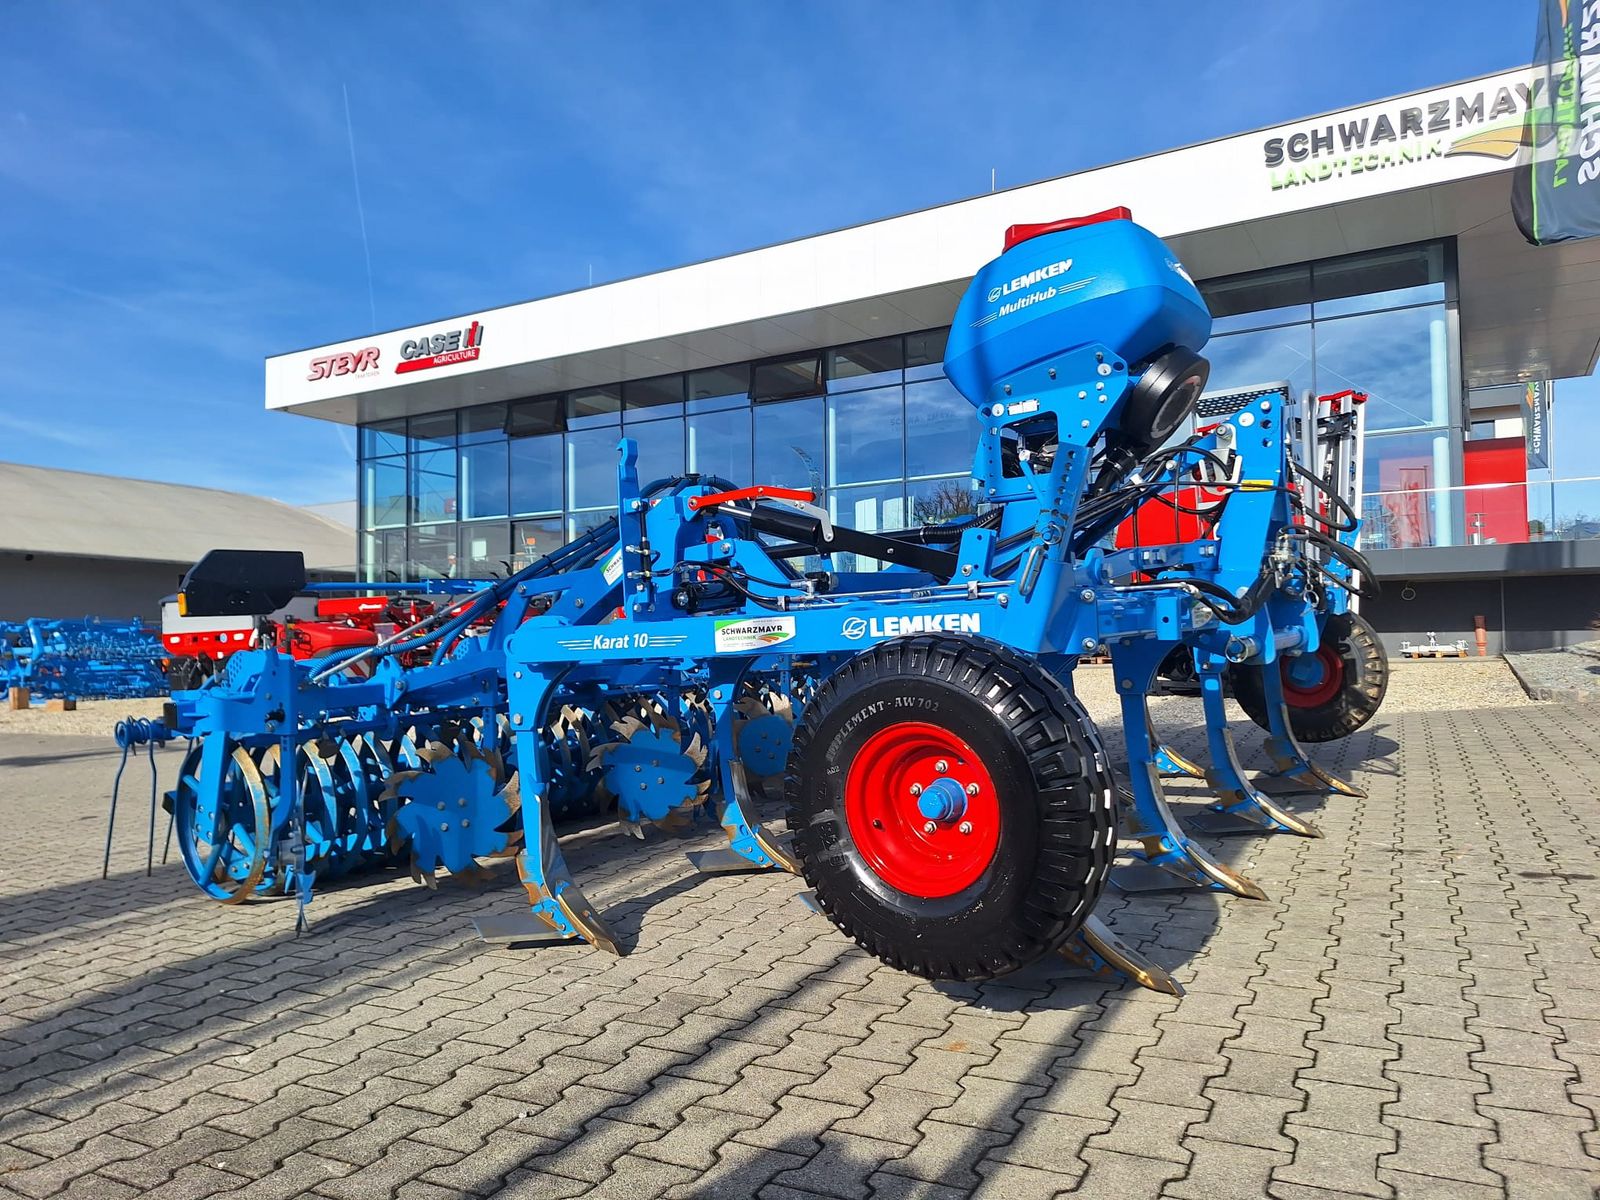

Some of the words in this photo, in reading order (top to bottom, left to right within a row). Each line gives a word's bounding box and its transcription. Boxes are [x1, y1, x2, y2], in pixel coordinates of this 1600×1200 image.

[1270, 138, 1443, 191] LANDTECHNIK
[1002, 258, 1073, 296] LEMKEN
[998, 286, 1057, 317] MultiHub
[400, 330, 462, 360] CASE
[433, 349, 476, 365] AGRICULTURE
[306, 346, 380, 382] STEYR
[721, 625, 783, 636] SCHWARZMAYR
[869, 612, 981, 638] LEMKEN
[593, 634, 629, 650] Karat
[633, 633, 649, 648] 10
